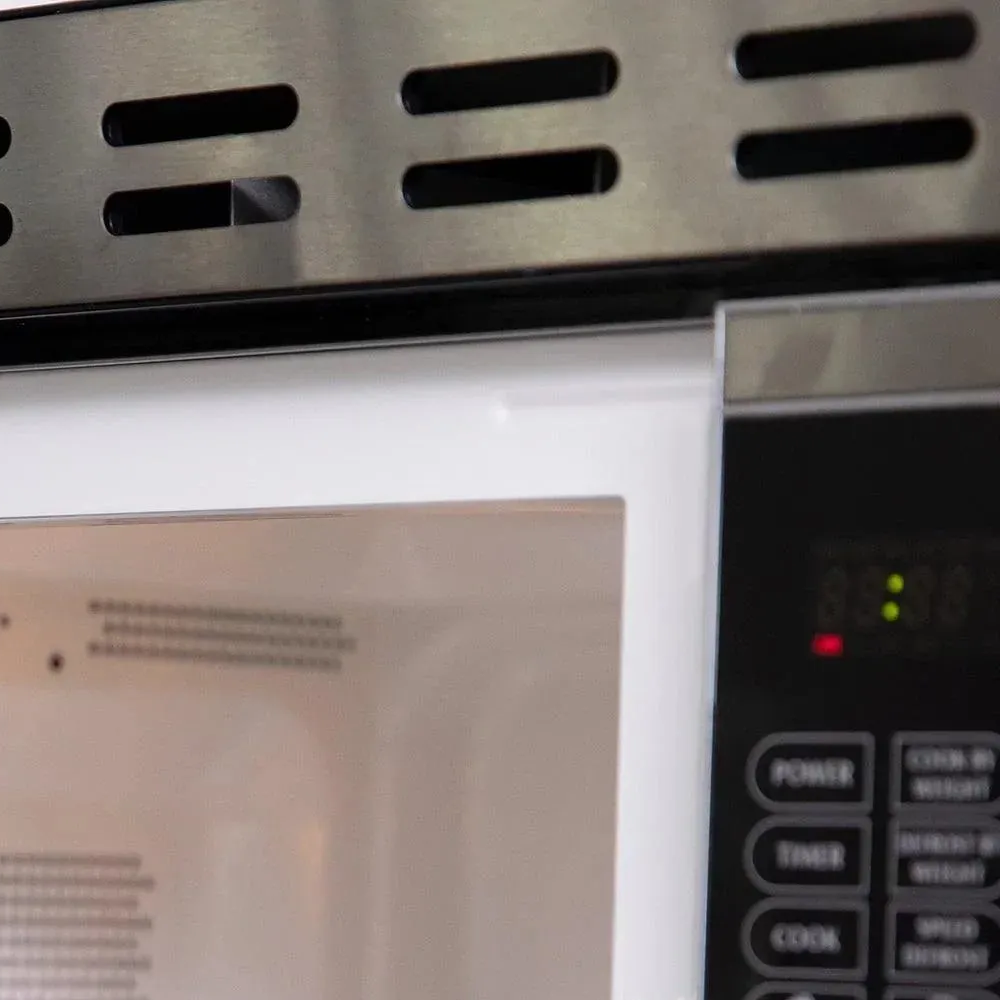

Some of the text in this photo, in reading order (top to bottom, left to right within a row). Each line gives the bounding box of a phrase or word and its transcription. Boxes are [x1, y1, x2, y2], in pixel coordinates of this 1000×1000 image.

[771, 758, 854, 787] POWER
[777, 840, 845, 870] TIMER
[770, 922, 841, 953] COOK
